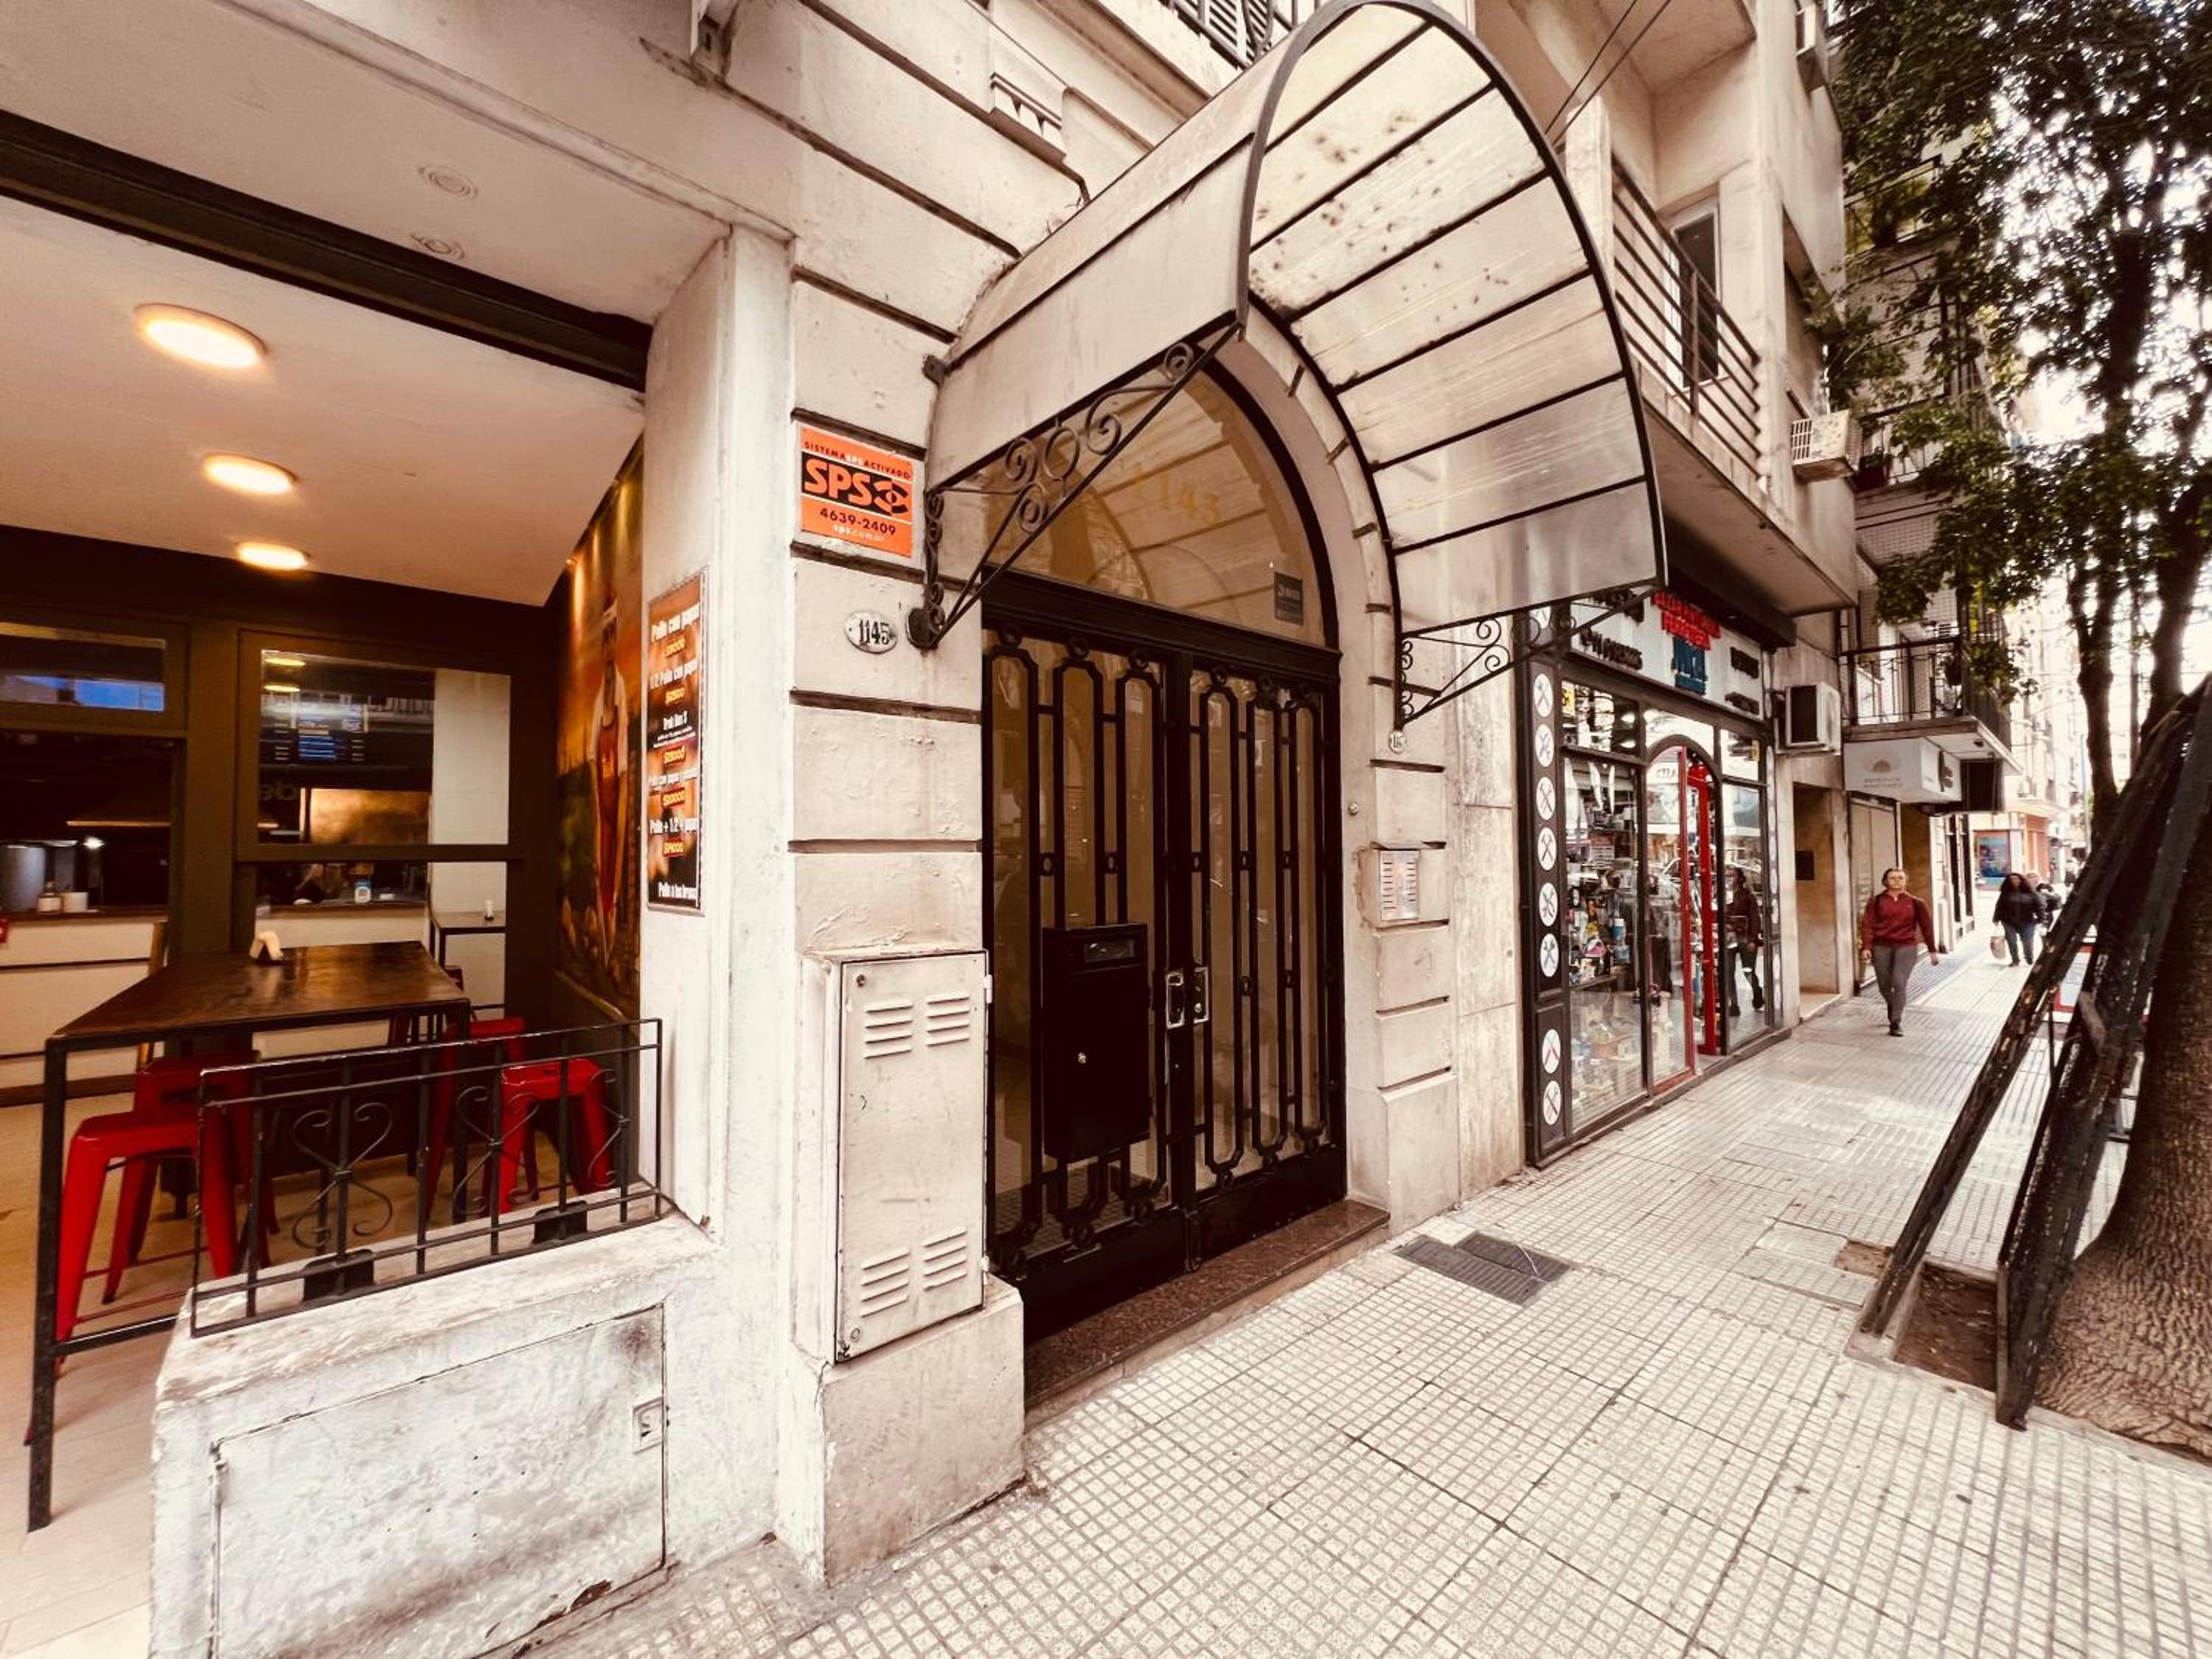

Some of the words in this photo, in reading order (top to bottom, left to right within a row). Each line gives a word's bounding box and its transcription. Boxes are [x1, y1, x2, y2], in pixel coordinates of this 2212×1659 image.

[803, 441, 846, 461] SISTEMA
[863, 459, 911, 480] ACTIVADO
[804, 457, 873, 507] SPS
[820, 507, 897, 537] 4639-2409
[859, 619, 891, 645] 1145
